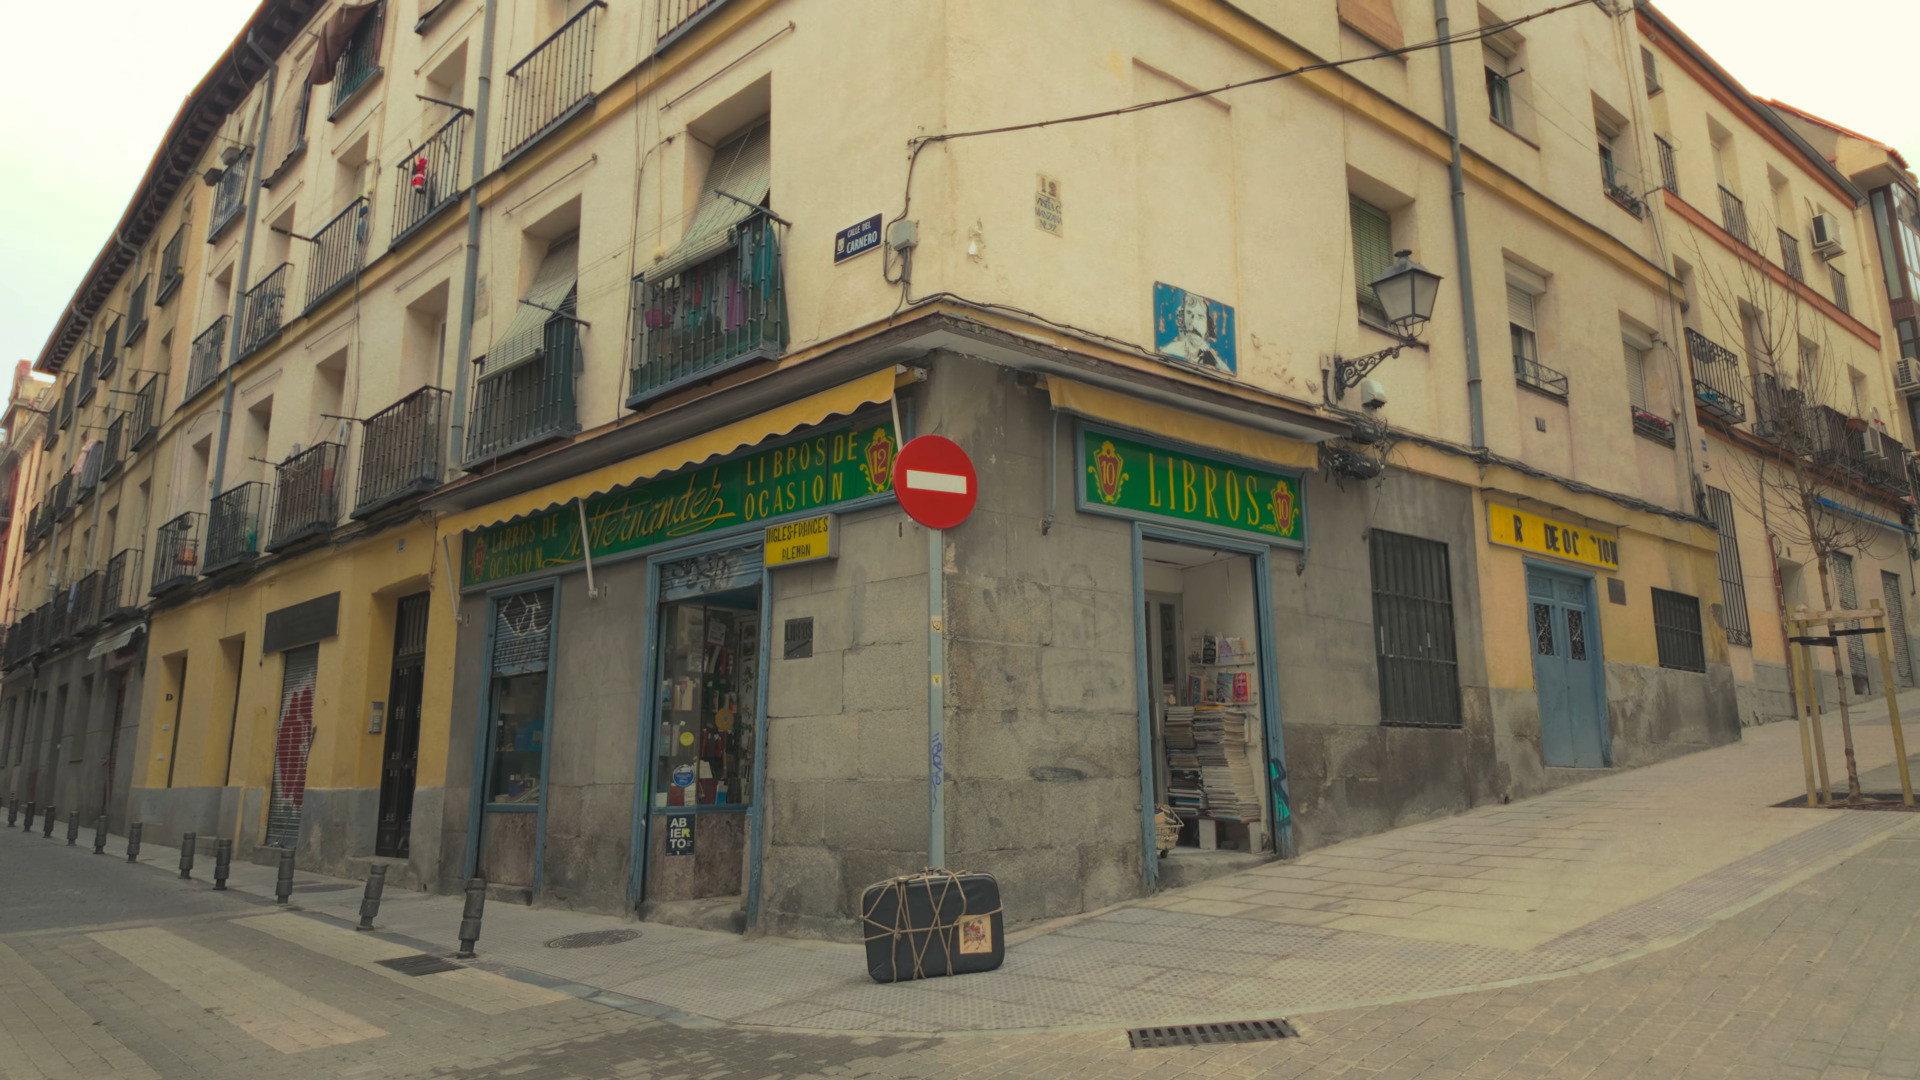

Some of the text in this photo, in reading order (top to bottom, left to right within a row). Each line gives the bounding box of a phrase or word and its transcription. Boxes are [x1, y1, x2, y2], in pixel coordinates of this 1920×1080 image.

[847, 220, 871, 238] CALLE DEL
[846, 231, 877, 253] CARNERO
[746, 431, 858, 486] LIBROS DE
[873, 449, 887, 475] 12
[1101, 461, 1114, 486] 10
[744, 471, 844, 520] OCASION
[1149, 453, 1260, 526] LIBROS
[1280, 498, 1290, 520] 10
[492, 521, 536, 554] LIBROS
[542, 513, 559, 540] DE
[490, 546, 543, 579] OCASION
[670, 817, 687, 828] AB
[670, 828, 691, 838] IER
[669, 838, 686, 849] TO
